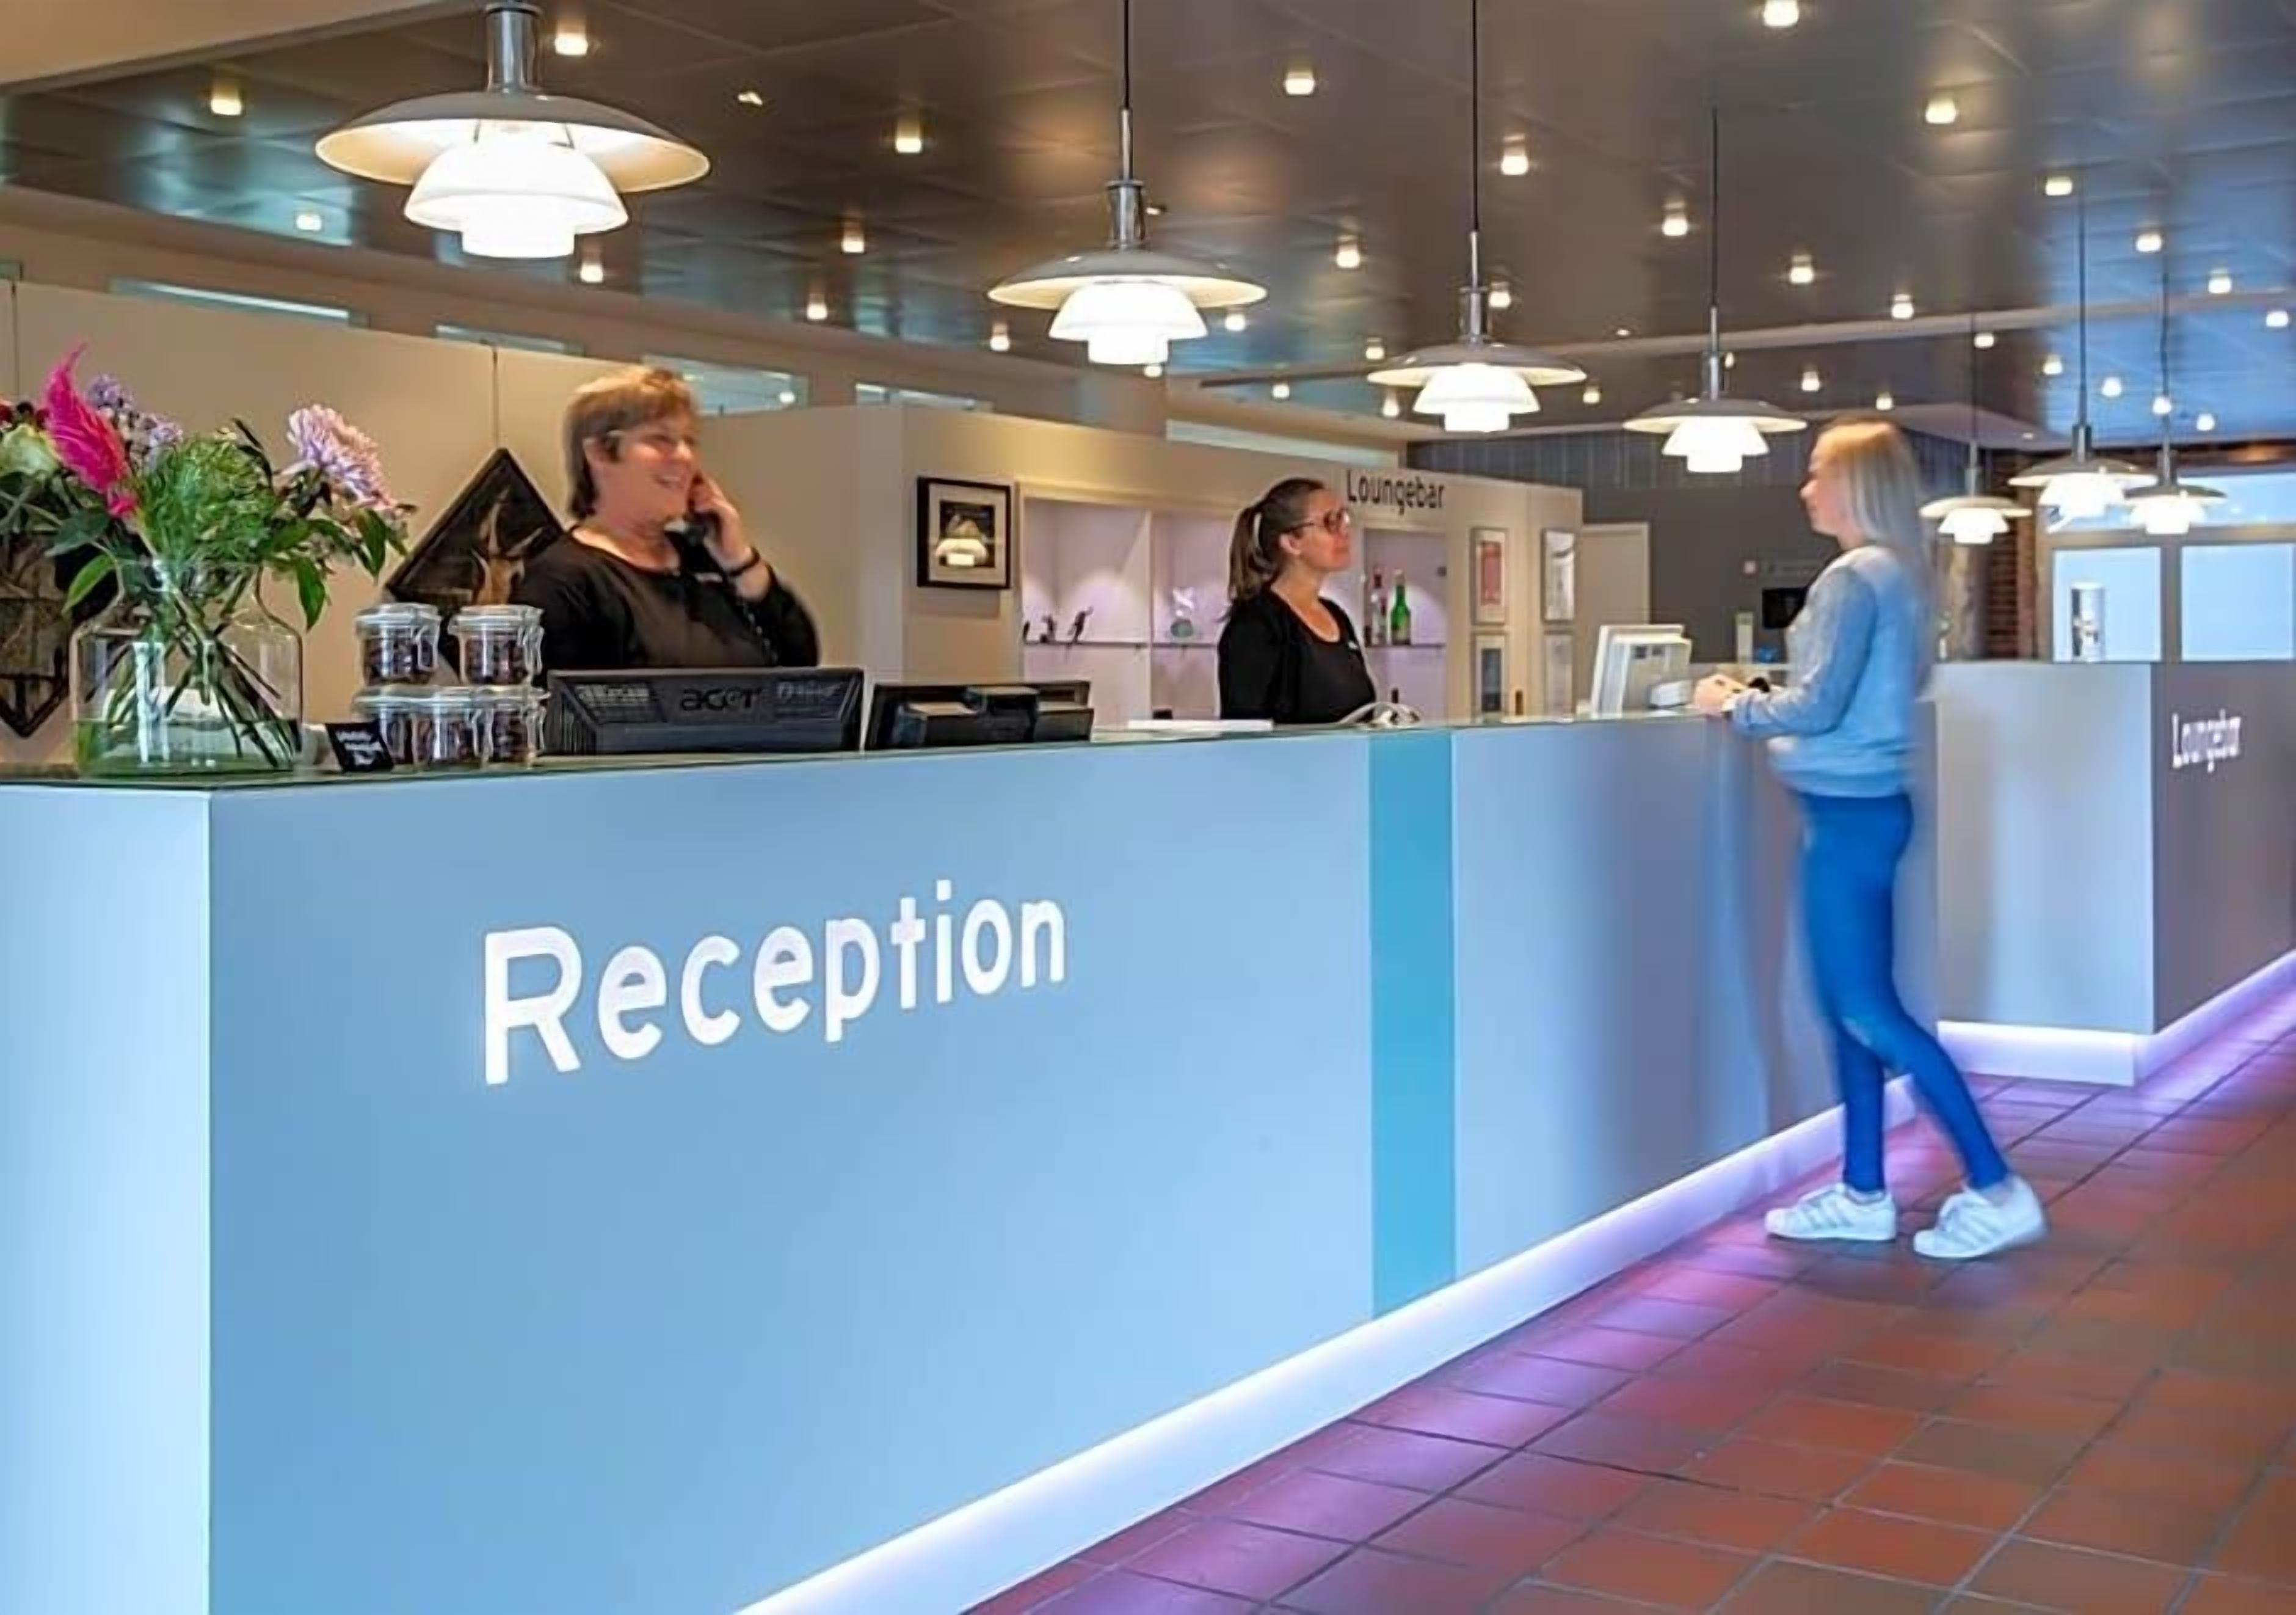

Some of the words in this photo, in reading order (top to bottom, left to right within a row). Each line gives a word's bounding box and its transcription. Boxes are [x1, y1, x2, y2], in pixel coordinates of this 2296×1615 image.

[1347, 469, 1444, 516] Loungebar
[680, 688, 761, 711] acer
[484, 879, 1066, 1086] Reception
